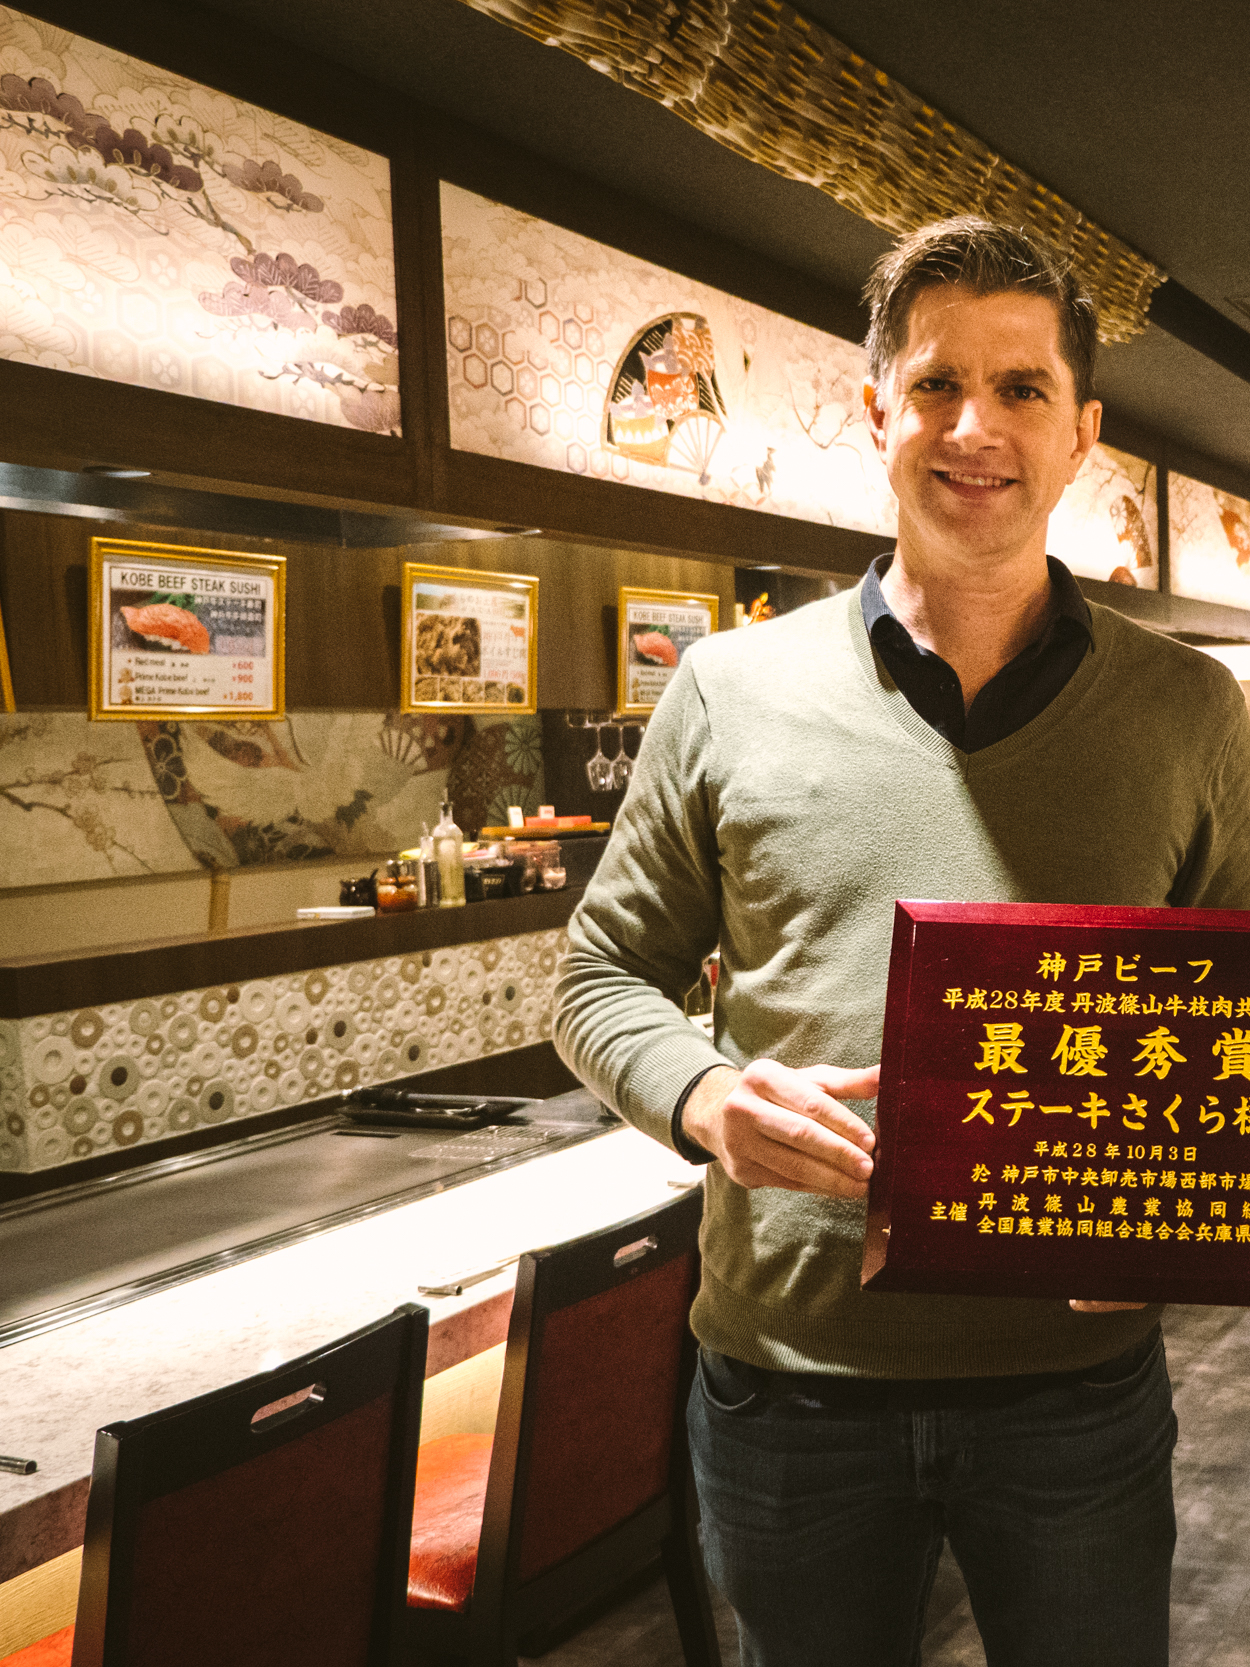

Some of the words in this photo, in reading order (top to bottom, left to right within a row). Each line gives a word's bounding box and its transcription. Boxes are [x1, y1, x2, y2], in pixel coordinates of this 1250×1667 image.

[121, 571, 154, 588] KOBE
[158, 574, 187, 589] BEEF
[191, 577, 226, 592] STEAK
[230, 580, 261, 596] SUSHI
[1036, 951, 1214, 984] 神戸ビーフ
[941, 987, 1067, 1014] 平成28年度
[1033, 1140, 1198, 1162] 平成28年10月3日
[929, 1201, 968, 1222] 主催
